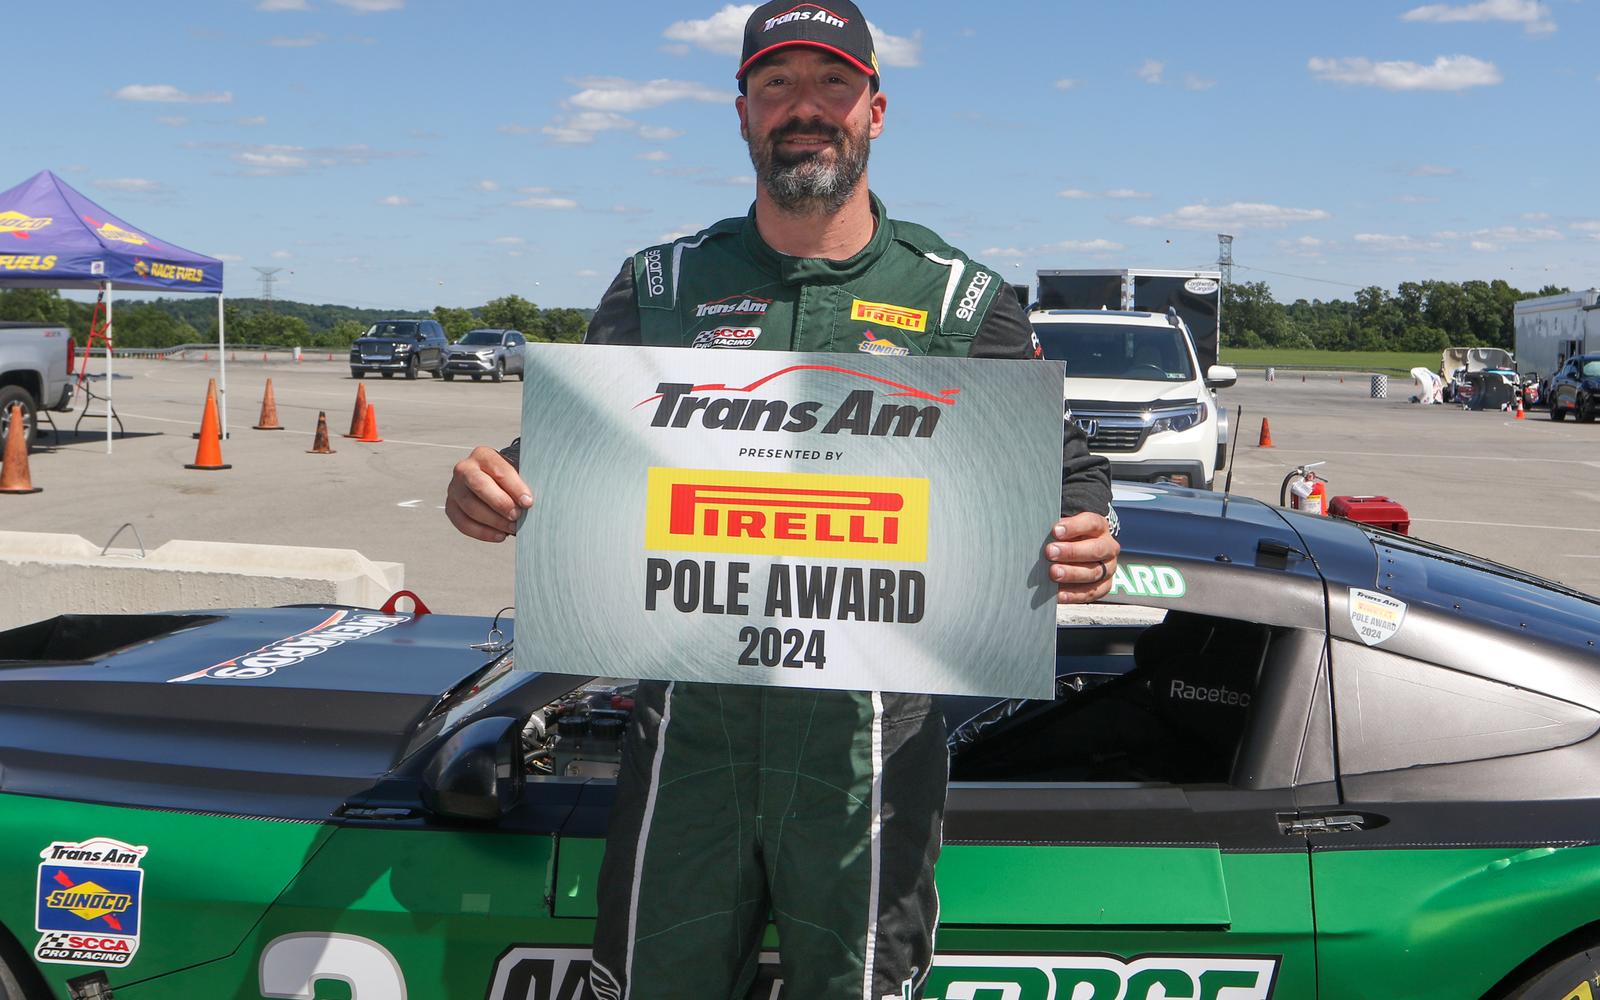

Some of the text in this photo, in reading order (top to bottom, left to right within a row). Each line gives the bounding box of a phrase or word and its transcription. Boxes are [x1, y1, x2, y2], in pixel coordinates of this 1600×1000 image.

[763, 10, 845, 32] Trans Am
[0, 255, 57, 270] FUELS
[151, 262, 176, 278] RACE
[175, 266, 204, 282] FUELS
[645, 250, 664, 295] sparco
[956, 271, 988, 320] sparco
[695, 300, 768, 317] Trans Am
[857, 303, 922, 328] PIRELLI
[713, 338, 753, 346] RACING
[714, 328, 756, 338] SCCA
[860, 342, 908, 356] SUNOCO
[650, 381, 942, 438] Trans Am
[739, 446, 844, 461] PRESENTED BY
[669, 483, 904, 545] PIRELLI
[645, 557, 927, 625] POLE AWARD
[1351, 611, 1369, 624] POLE
[1370, 617, 1397, 632] AWARD
[1360, 626, 1382, 640] 2024
[213, 614, 406, 679] MENARDS
[737, 626, 827, 670] 2024
[51, 845, 138, 864] Trans Am
[50, 892, 130, 911] SUNOCO
[68, 936, 130, 952] SCCA
[40, 949, 127, 962] PRO RACING
